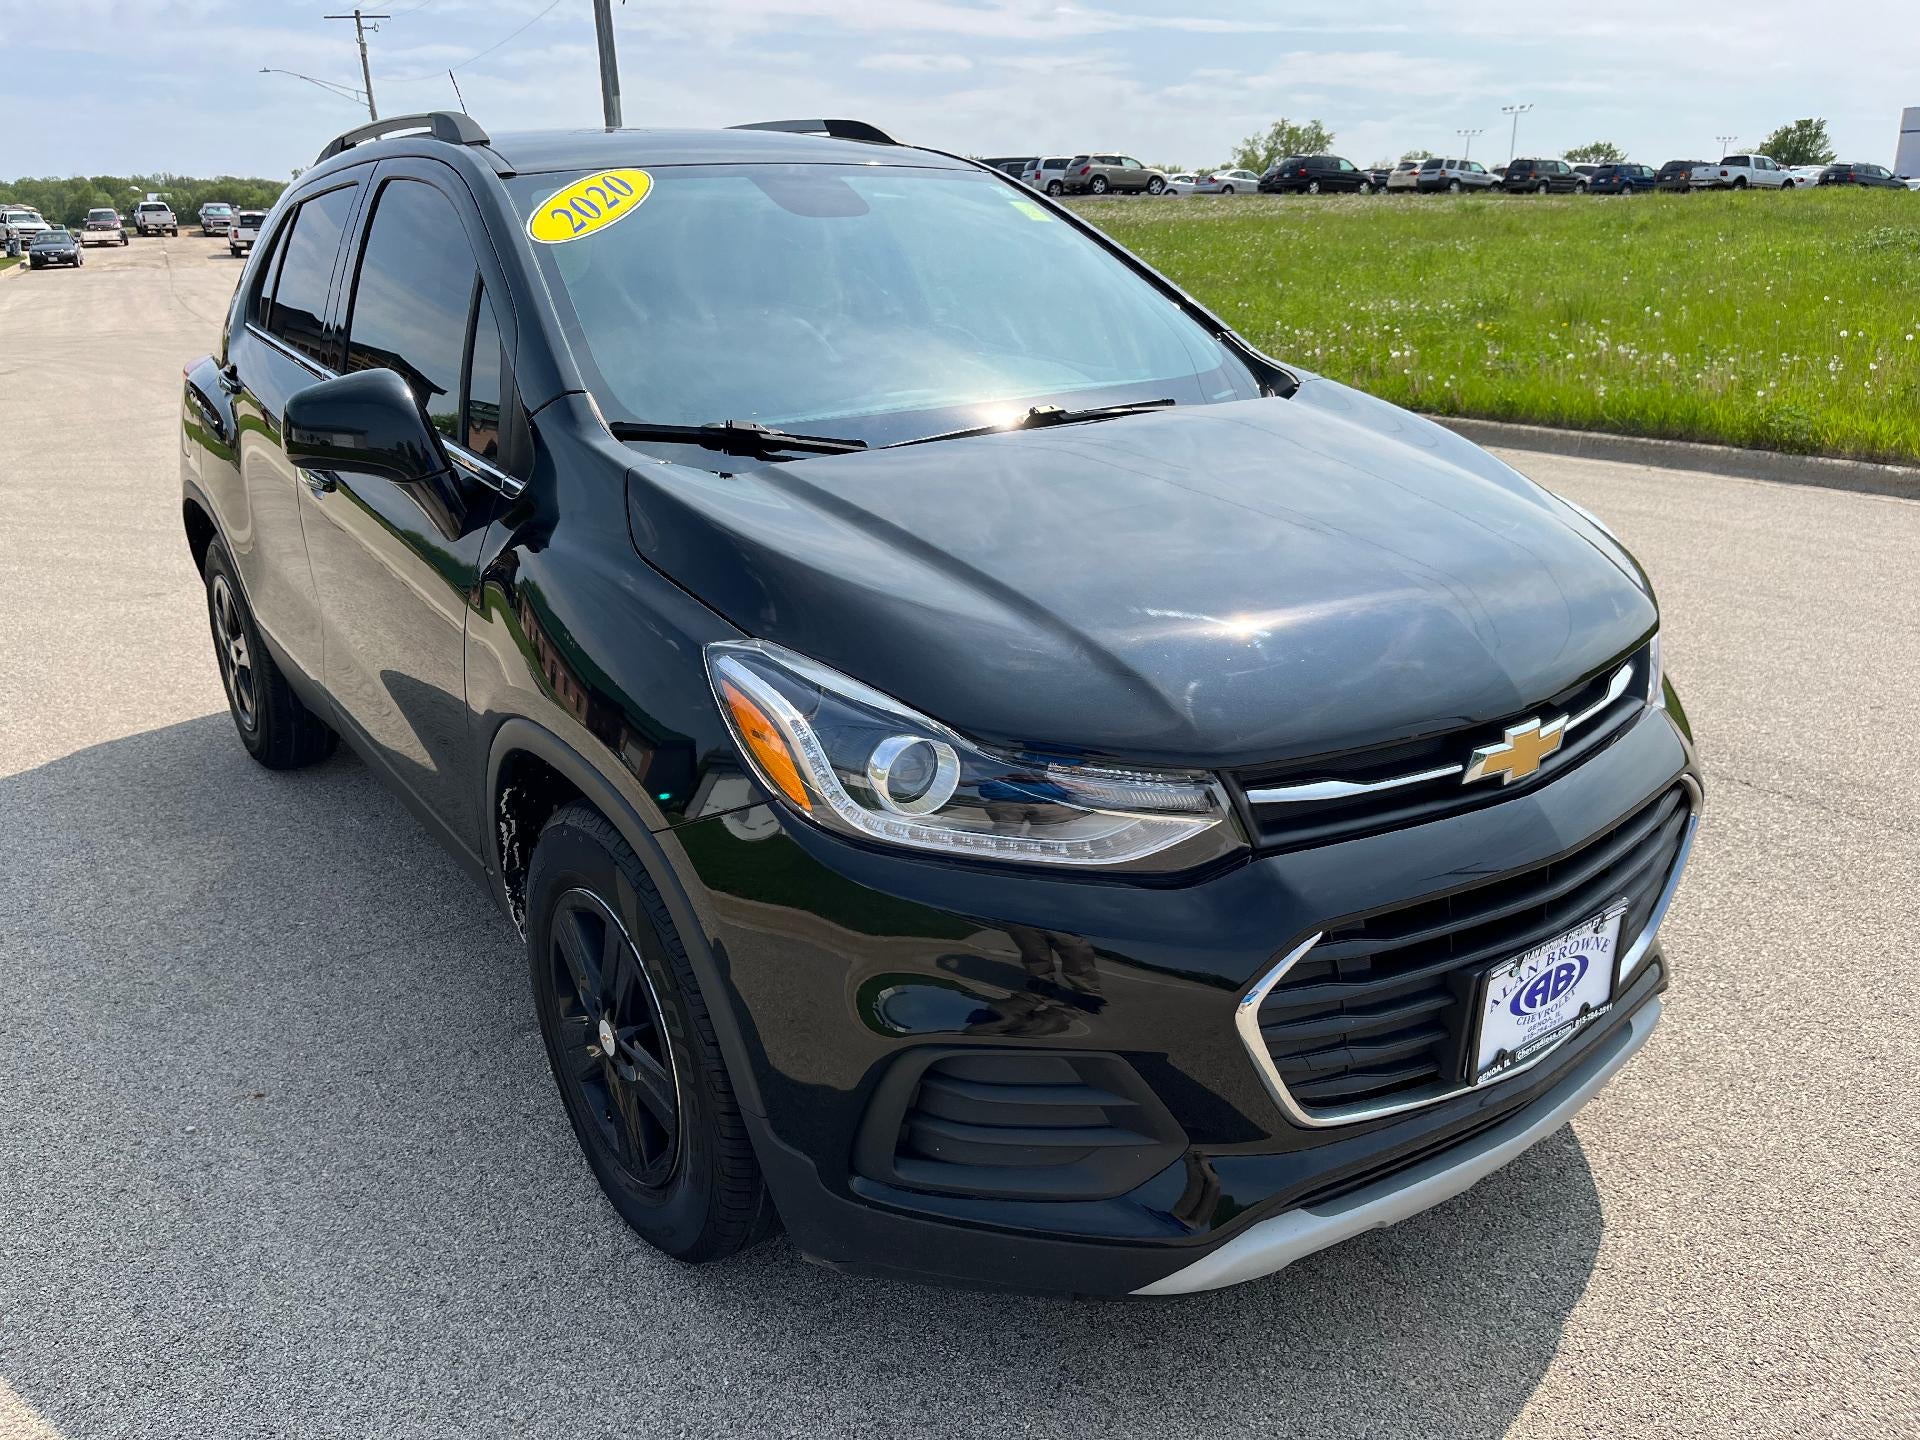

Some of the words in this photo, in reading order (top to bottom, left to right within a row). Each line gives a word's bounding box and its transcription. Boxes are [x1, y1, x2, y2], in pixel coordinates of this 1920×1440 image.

[551, 175, 634, 233] 2020
[1489, 960, 1539, 1014] ALAN
[1546, 935, 1611, 967] BROWNE
[1524, 962, 1577, 1010] AB
[1516, 989, 1576, 1026] CHEVROLET
[1477, 1065, 1503, 1084] GENOA,
[1504, 1059, 1511, 1068] IL
